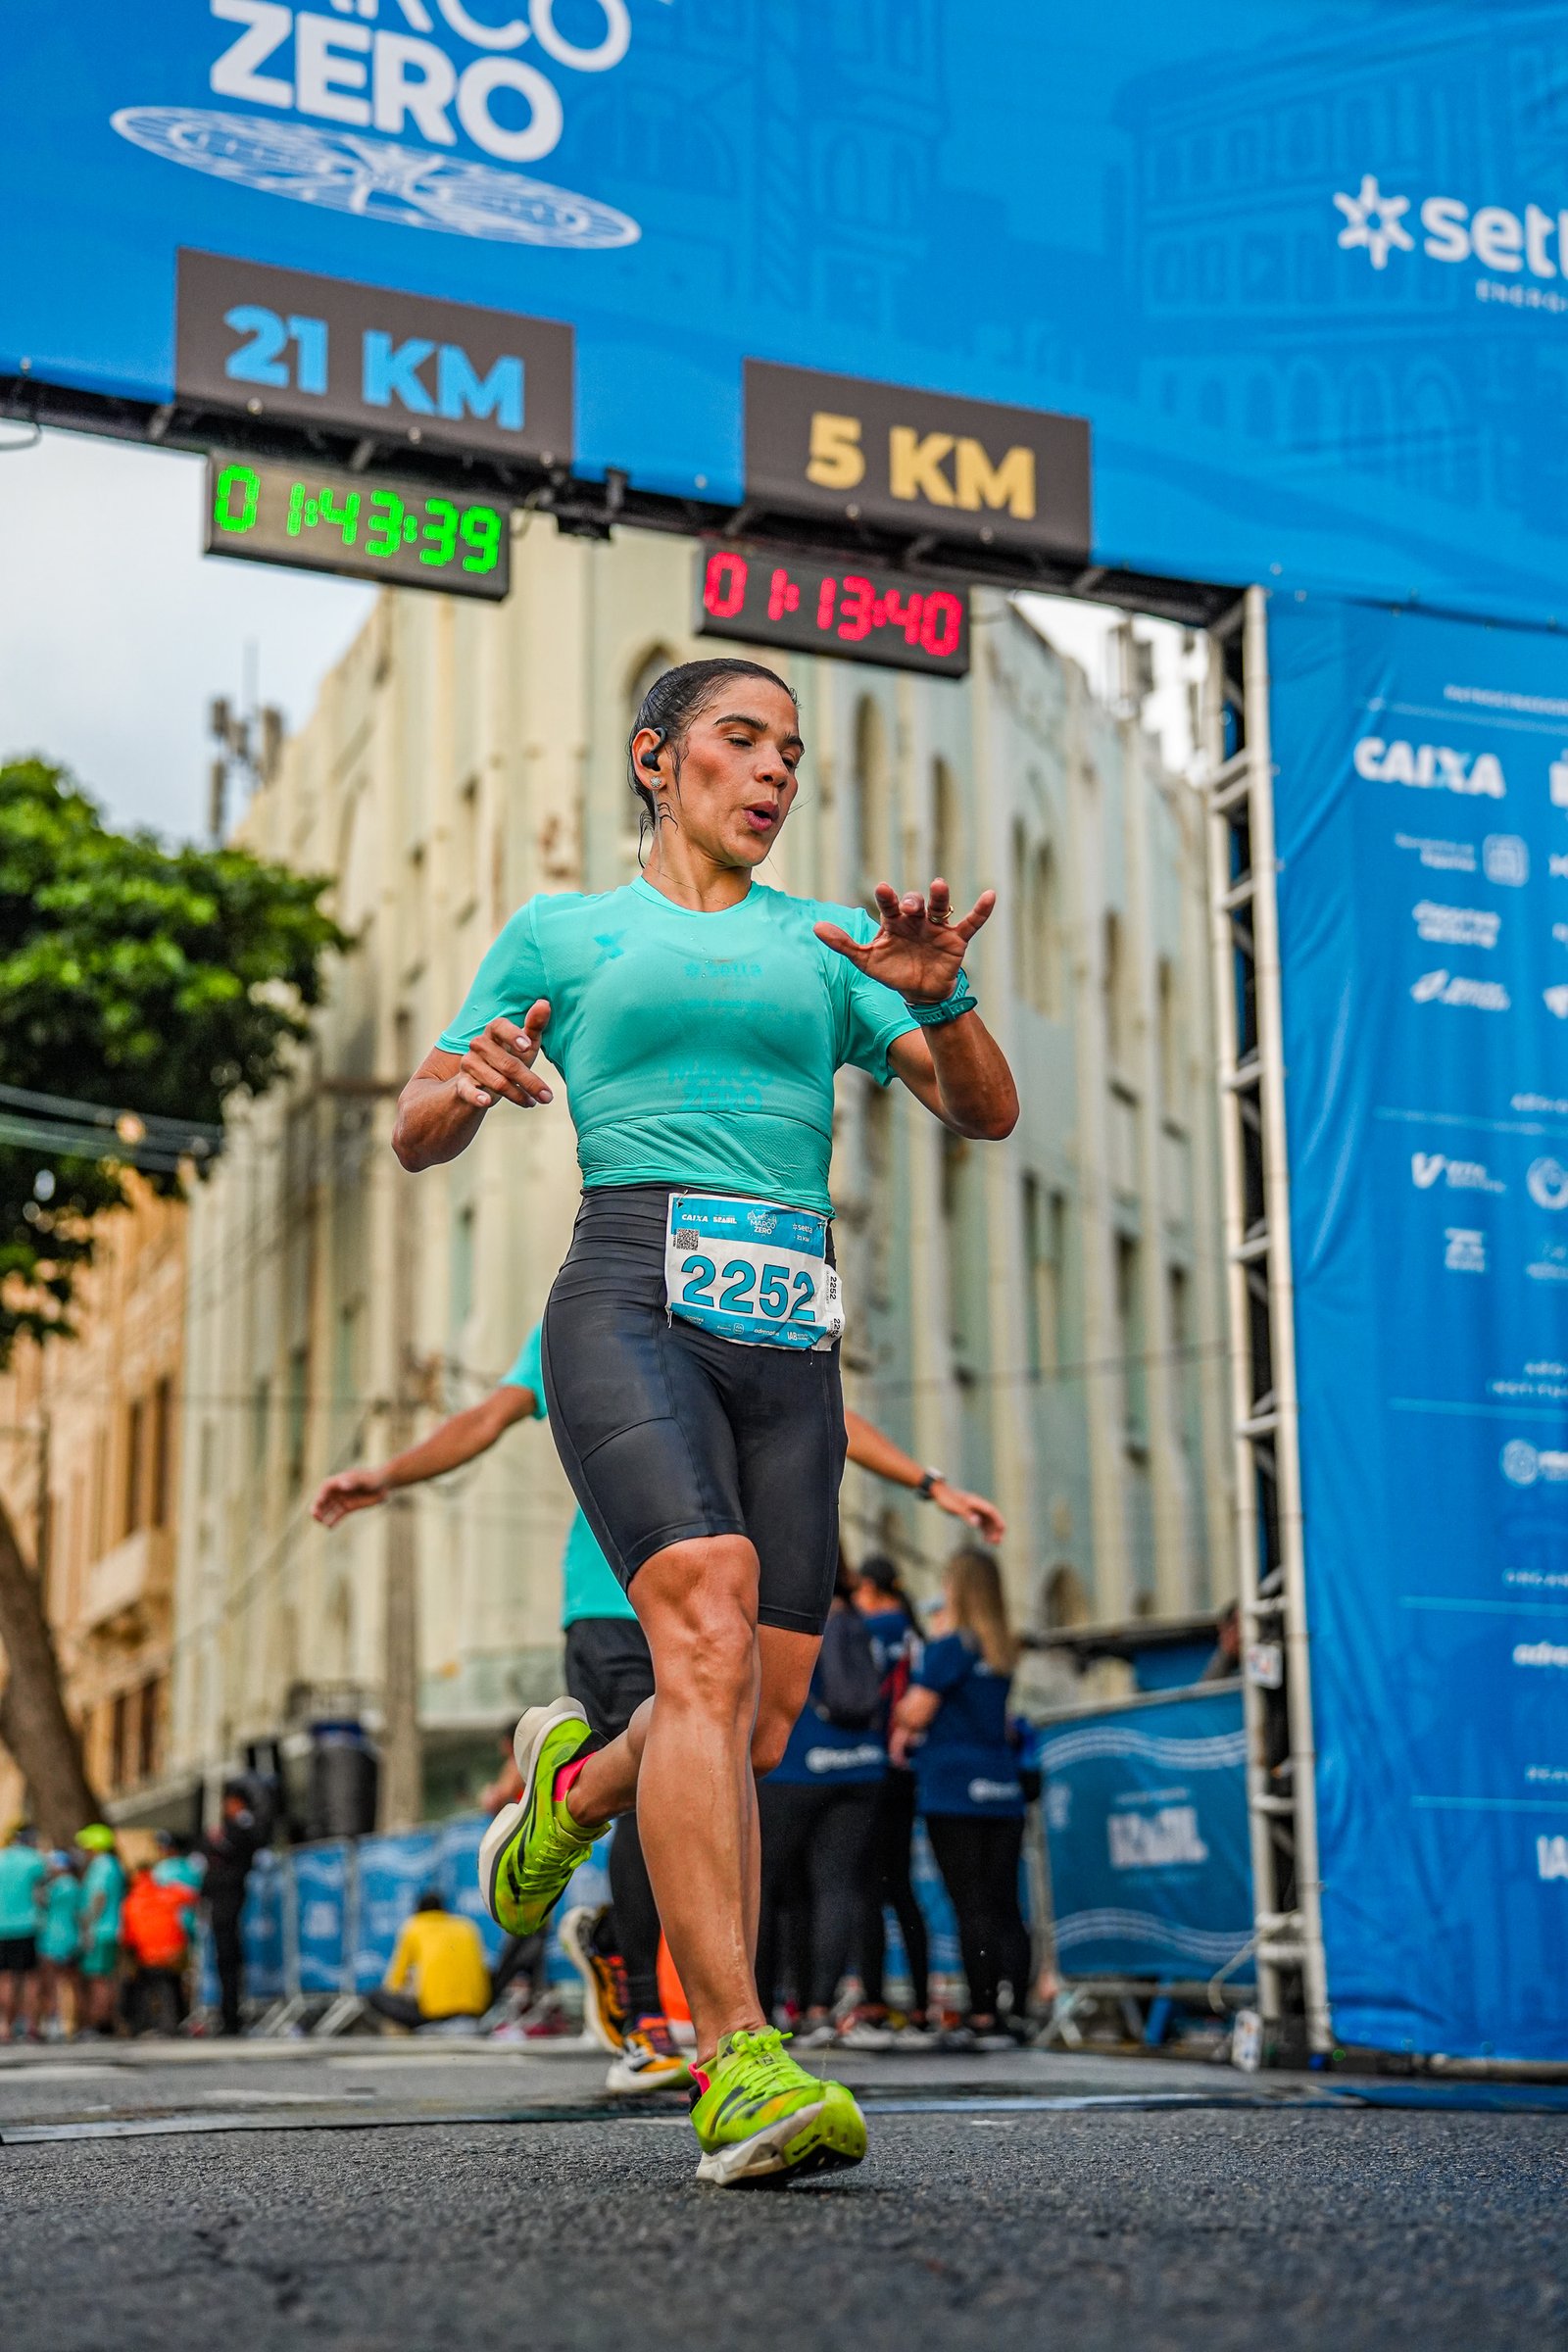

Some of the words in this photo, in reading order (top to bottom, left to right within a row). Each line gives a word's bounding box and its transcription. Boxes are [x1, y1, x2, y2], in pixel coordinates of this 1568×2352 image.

[210, 3, 564, 163] ZERO
[224, 305, 328, 394] 21
[363, 329, 524, 431] KM
[807, 412, 864, 489] 5
[889, 428, 1038, 521] KM
[1354, 736, 1506, 799] CAIXA
[681, 1214, 709, 1223] CAIXA
[751, 1219, 776, 1230] MARCO
[754, 1226, 772, 1235] ZERO
[681, 1254, 815, 1323] 2252
[829, 1276, 838, 1300] 2252
